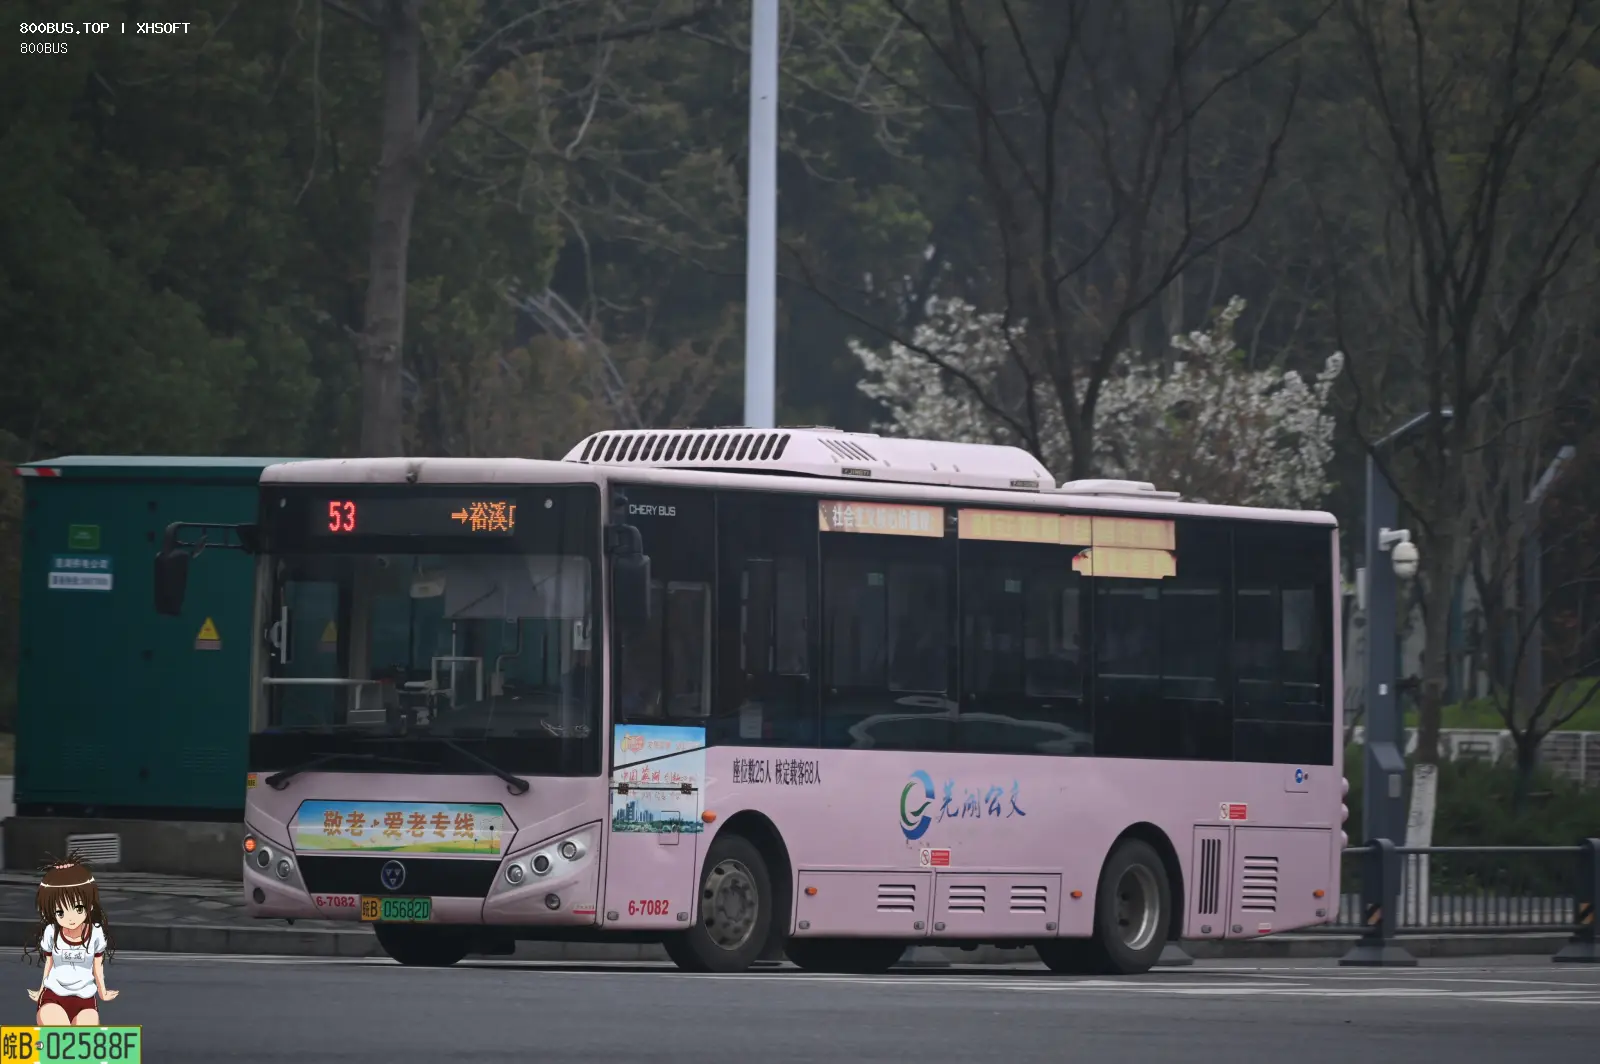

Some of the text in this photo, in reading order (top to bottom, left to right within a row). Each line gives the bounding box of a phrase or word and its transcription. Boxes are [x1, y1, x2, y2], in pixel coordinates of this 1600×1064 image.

[329, 501, 355, 532] 53
[629, 504, 676, 516] CHERY BUS
[733, 757, 771, 784] 座位数25人
[316, 896, 355, 907] 6-7082
[384, 901, 429, 918] 05682D
[628, 900, 669, 915] 6-7082
